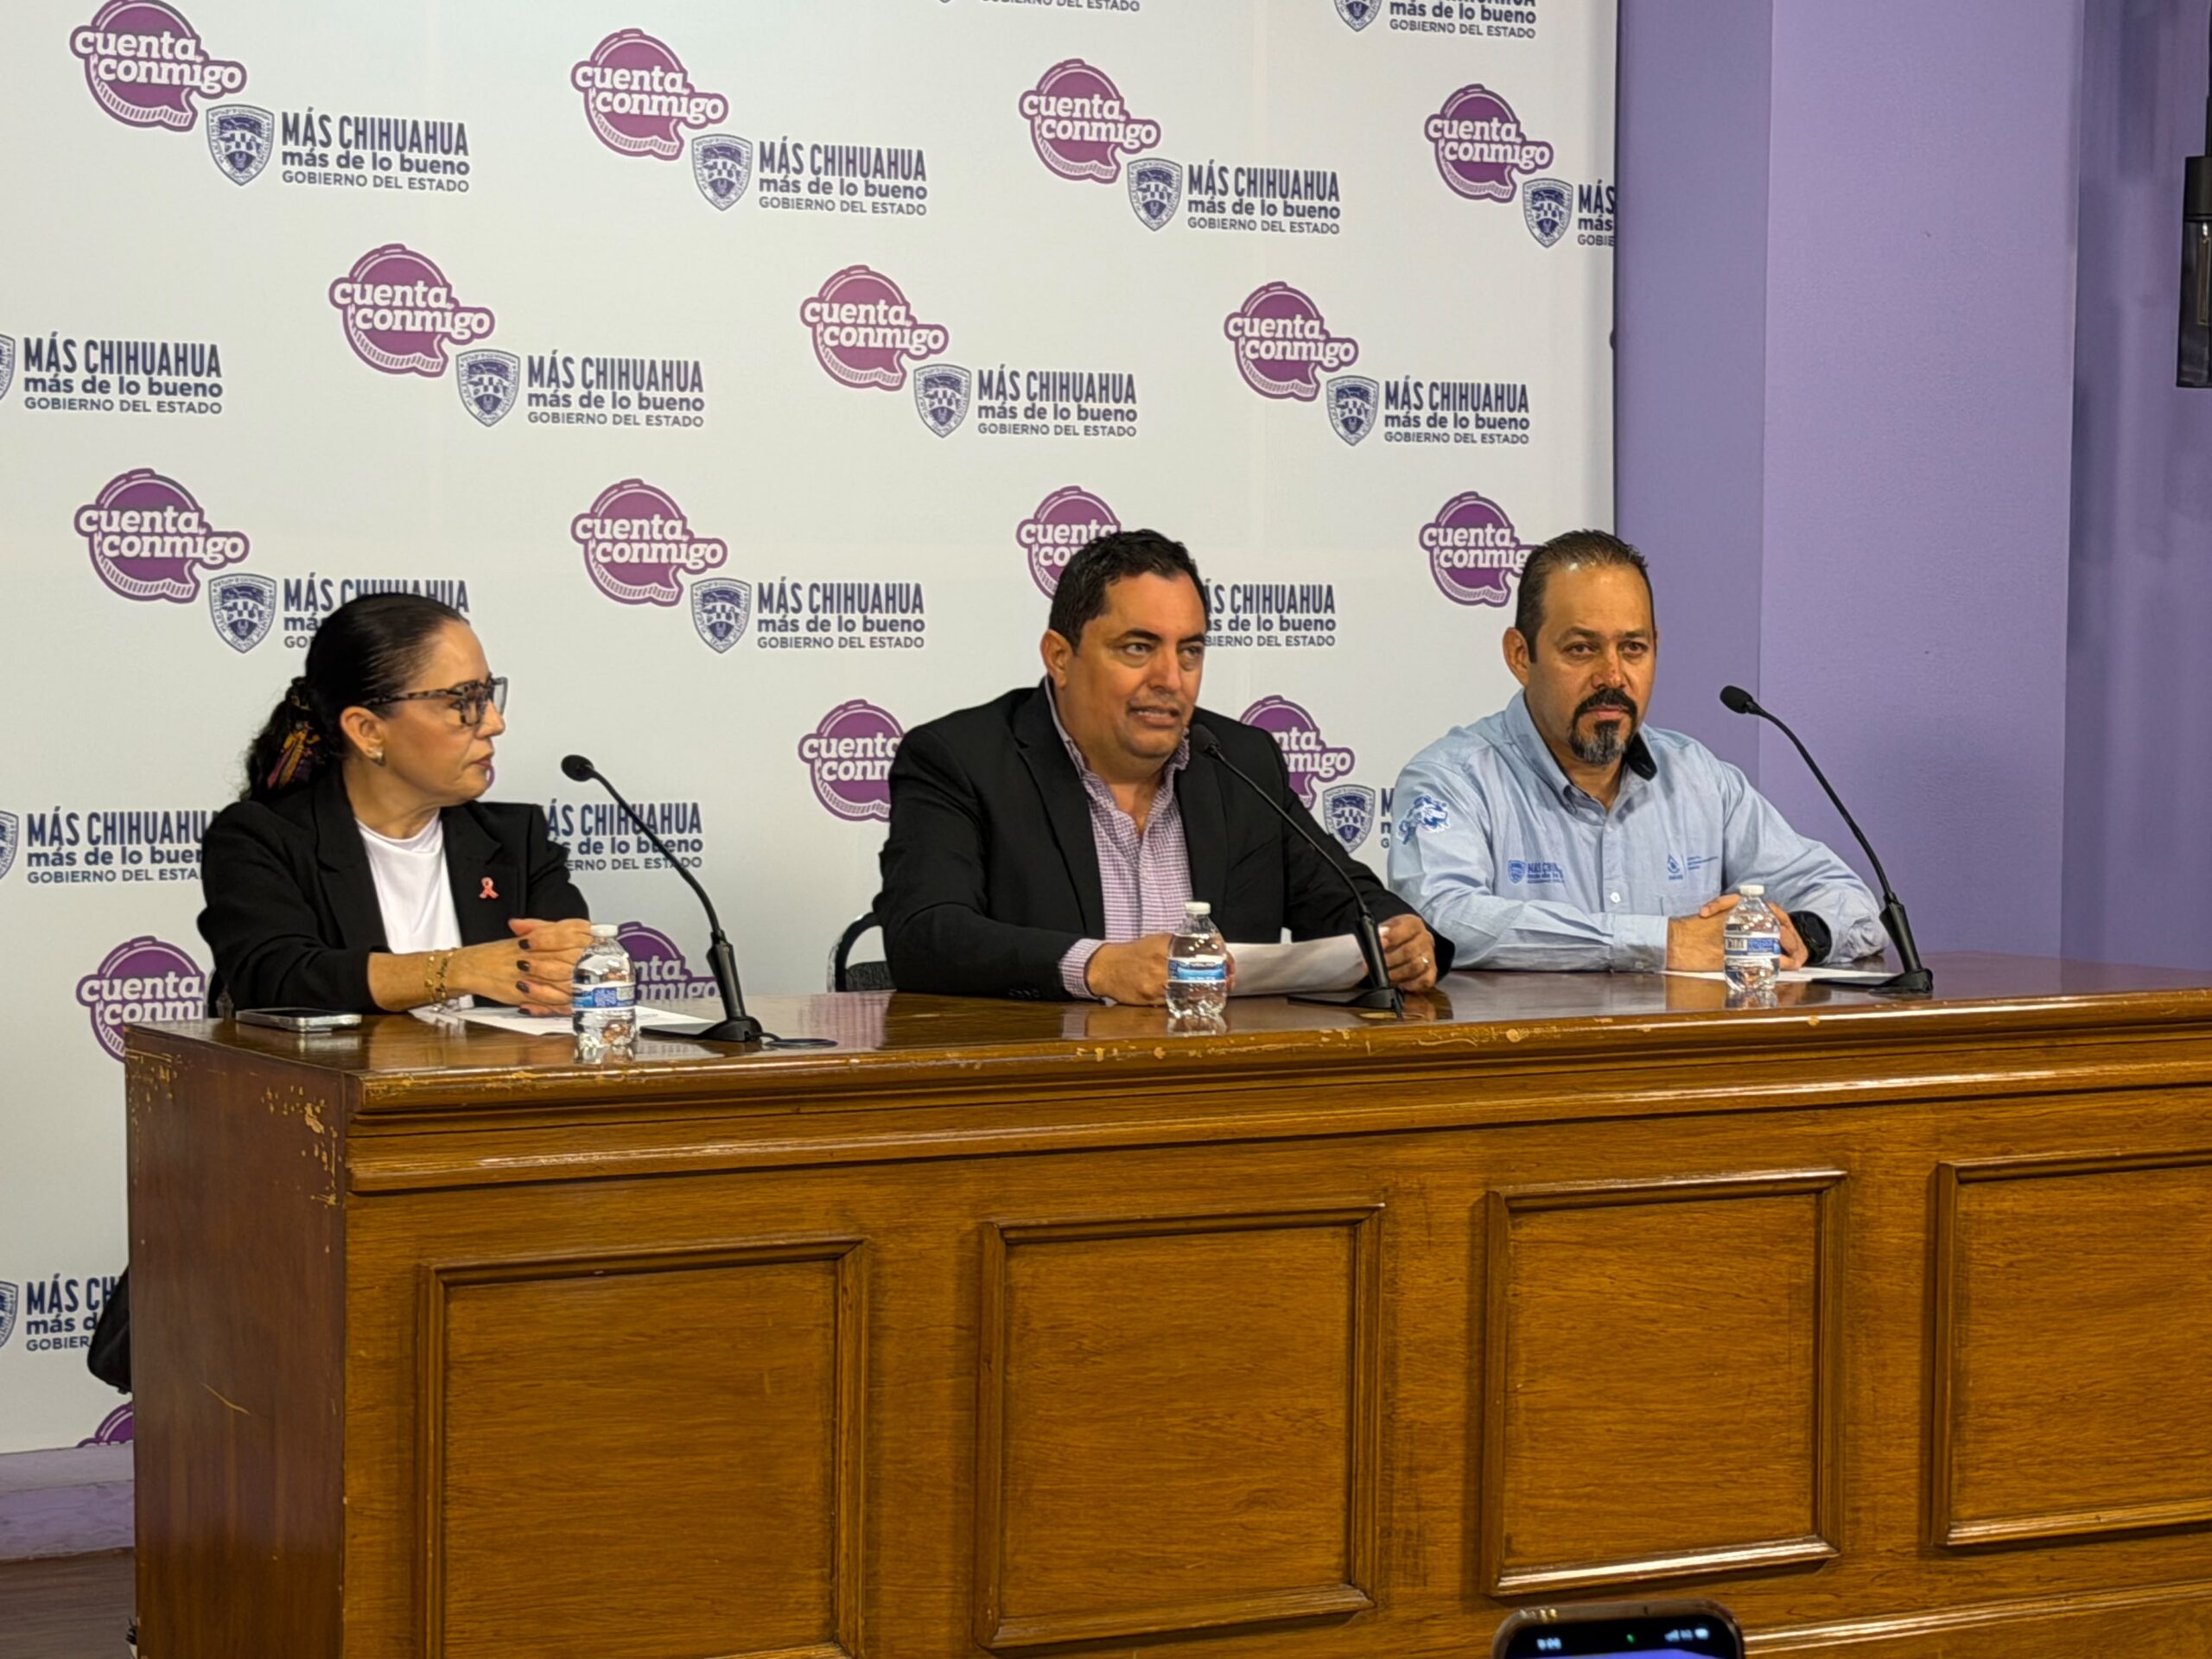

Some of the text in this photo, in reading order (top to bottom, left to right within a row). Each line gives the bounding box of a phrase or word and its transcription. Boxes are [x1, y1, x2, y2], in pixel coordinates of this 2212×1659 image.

[1432, 1, 1453, 19] de
[1459, 3, 1476, 20] lo
[1480, 5, 1536, 24] bueno
[1389, 18, 1536, 39] GOBIERNO DEL ESTADO
[75, 31, 204, 62] cuenta
[99, 58, 243, 94] conmigo
[575, 65, 690, 96] cuenta
[595, 91, 724, 124] conmigo
[1021, 93, 1125, 122] cuenta
[282, 106, 332, 149] MÁS
[339, 115, 468, 156] CHIHUAHUA
[1041, 116, 1157, 148] conmigo
[1427, 117, 1522, 142] cuenta
[282, 149, 470, 175] más de lo bueno
[760, 136, 804, 177] MÁS
[810, 143, 926, 181] CHIHUAHUA
[1444, 137, 1550, 167] conmigo
[282, 170, 469, 193] GOBIERNO DEL ESTADO
[759, 176, 927, 200] más de lo bueno
[1188, 159, 1229, 199] MÁS
[1234, 167, 1340, 202] CHIHUAHUA
[759, 196, 927, 216] GOBIERNO DEL ESTADO
[1188, 199, 1340, 219] más de lo bueno
[1187, 218, 1340, 235] GOBIERNO DEL ESTADO
[1578, 214, 1613, 232] más
[333, 279, 454, 308] cuenta
[355, 306, 491, 340] conmigo
[804, 298, 912, 327] cuenta
[823, 322, 944, 354] conmigo
[1227, 315, 1325, 340] cuenta
[24, 331, 77, 375] MÁS
[85, 340, 222, 378] CHIHUAHUA
[1245, 337, 1355, 366] conmigo
[528, 349, 575, 392] MÁS
[582, 357, 703, 393] CHIHUAHUA
[24, 374, 223, 397] más de lo bueno
[978, 364, 1020, 404] MÁS
[1027, 371, 1136, 404] CHIHUAHUA
[1385, 375, 1424, 413] MÁS
[1428, 382, 1529, 413] CHIHUAHUA
[24, 397, 222, 415] GOBIERNO DEL ESTADO
[528, 392, 705, 411] más de lo bueno
[978, 404, 1138, 423] más de lo bueno
[527, 412, 704, 428] GOBIERNO DEL ESTADO
[977, 423, 1137, 437] GOBIERNO DEL ESTADO
[1384, 413, 1530, 430] más de lo bueno
[1384, 431, 1529, 445] GOBIERNO DEL ESTADO
[79, 505, 207, 534] cuenta
[575, 513, 689, 541] cuenta
[102, 531, 245, 563] conmigo
[1423, 523, 1516, 548] cuenta
[595, 538, 723, 569] conmigo
[1440, 549, 1532, 574] conmig
[284, 572, 334, 613] MÁS
[758, 576, 803, 616] MÁS
[809, 582, 924, 614] CHIHUAHUA
[1230, 584, 1336, 614] CHIHUAHUA
[284, 613, 321, 632] má
[757, 615, 925, 632] más de lo bueno
[1228, 615, 1251, 632] de
[1256, 614, 1274, 632] lo
[1279, 614, 1337, 632] bueno
[757, 636, 925, 649] GOBIERNO DEL ESTADO
[1205, 635, 1336, 647] BIERNO DEL ESTADO
[27, 806, 79, 847] MÁS
[87, 810, 216, 847] CHIHUAHU
[548, 798, 575, 837] ÁS
[27, 849, 77, 868] más
[84, 847, 113, 866] de
[121, 846, 143, 865] lo
[577, 837, 604, 855] de
[610, 836, 630, 855] lo
[27, 868, 199, 884] GOBIERNO DEL ESTA
[611, 858, 639, 870] DEL
[81, 971, 204, 1002] cuenta
[104, 1001, 204, 1026] conmi
[27, 1273, 79, 1315] MÁS
[26, 1313, 76, 1335] más
[26, 1336, 91, 1351] GOBIER
